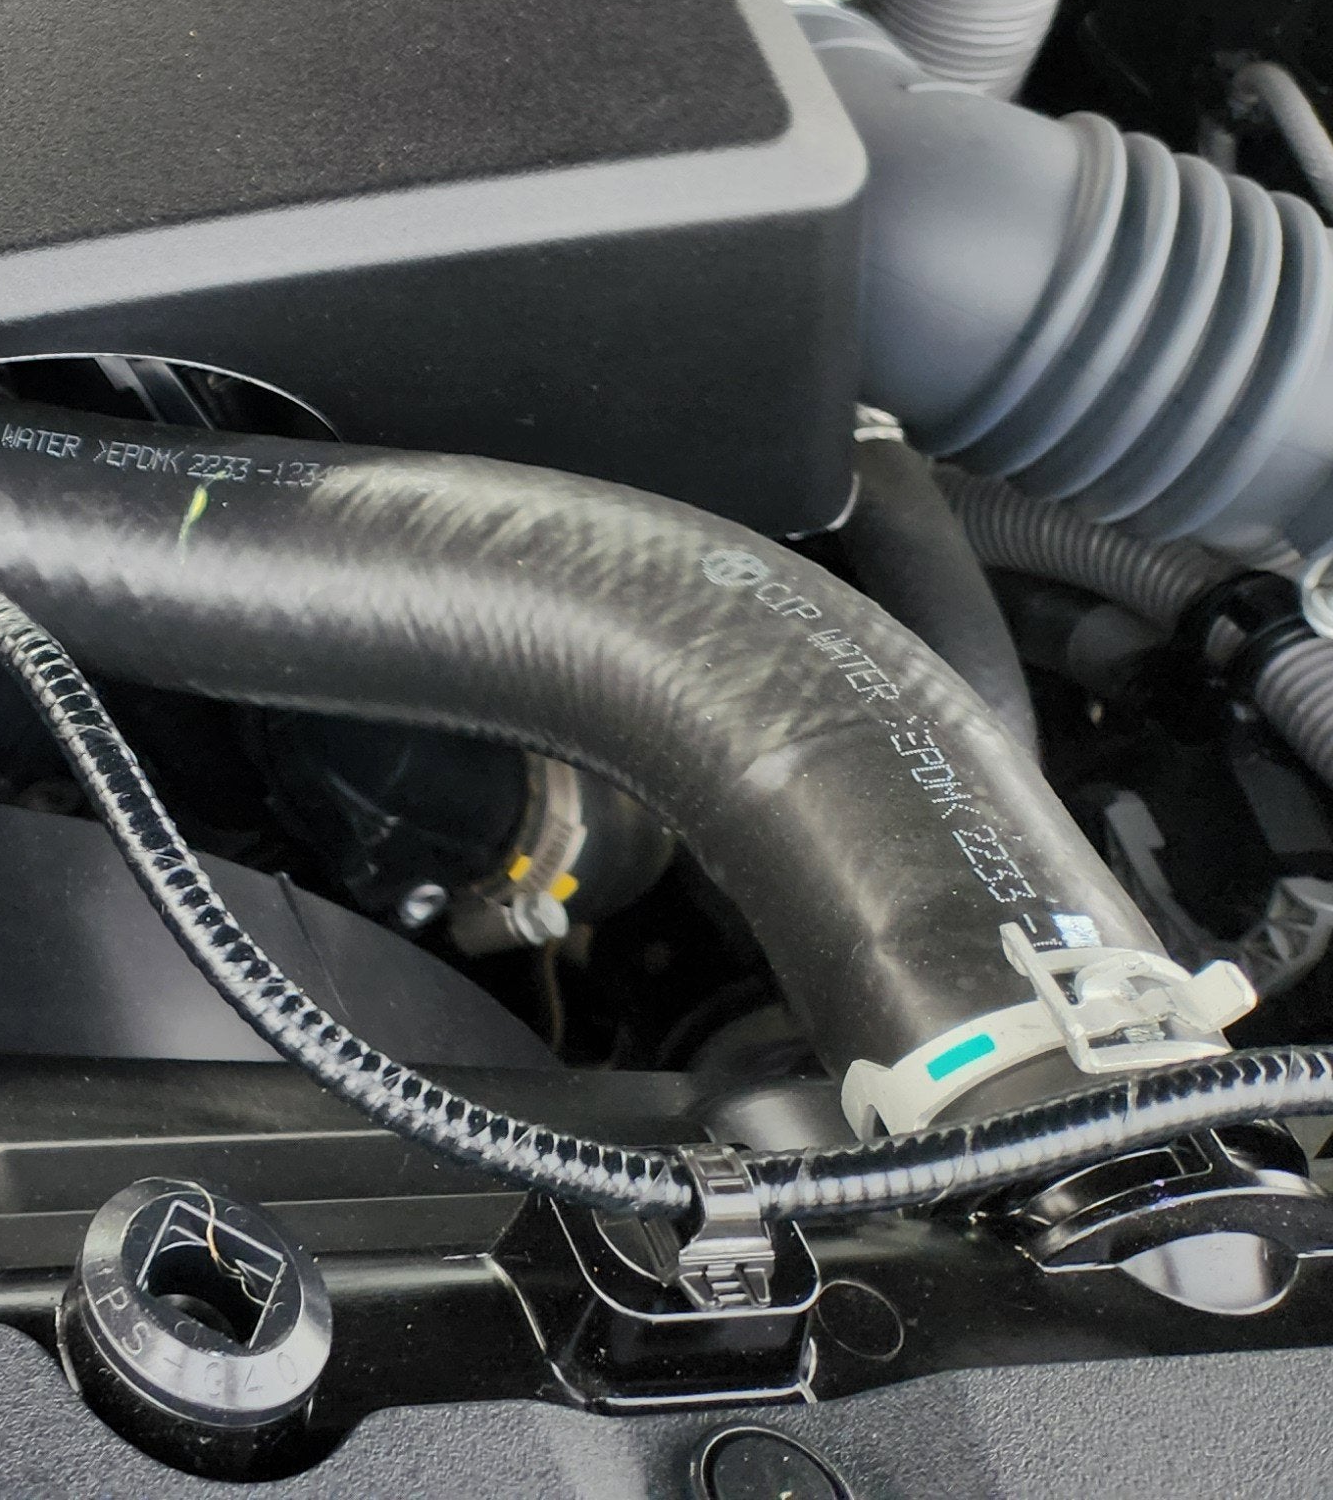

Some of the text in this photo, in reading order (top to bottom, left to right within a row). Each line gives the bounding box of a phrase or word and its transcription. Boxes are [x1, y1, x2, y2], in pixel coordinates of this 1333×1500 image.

[0, 422, 82, 459] WATER
[754, 582, 823, 620] CIP
[806, 628, 900, 703] WATER
